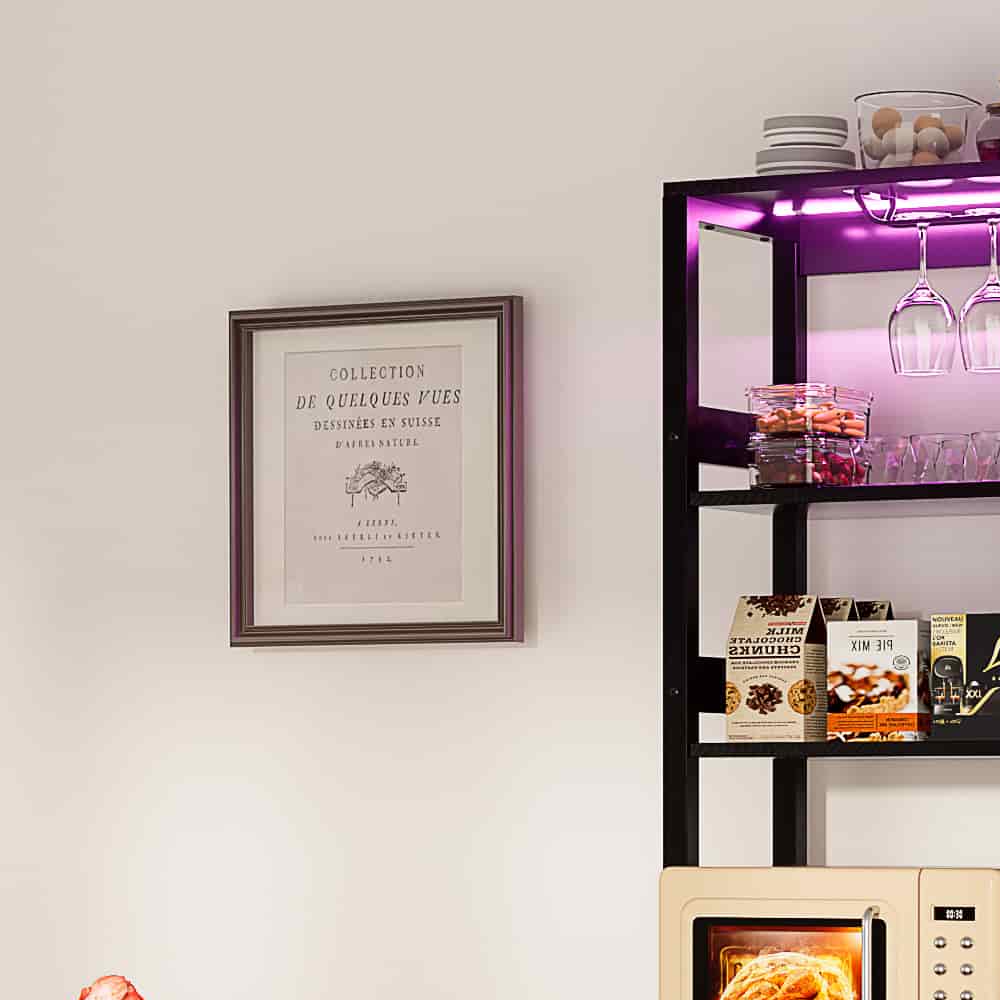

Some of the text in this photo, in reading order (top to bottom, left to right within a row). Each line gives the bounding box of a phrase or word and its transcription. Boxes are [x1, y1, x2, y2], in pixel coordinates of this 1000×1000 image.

[329, 364, 425, 382] COLLECTION
[296, 388, 462, 411] DE QUELQUES VUES
[381, 417, 397, 429] EN
[401, 416, 441, 428] SUISSE
